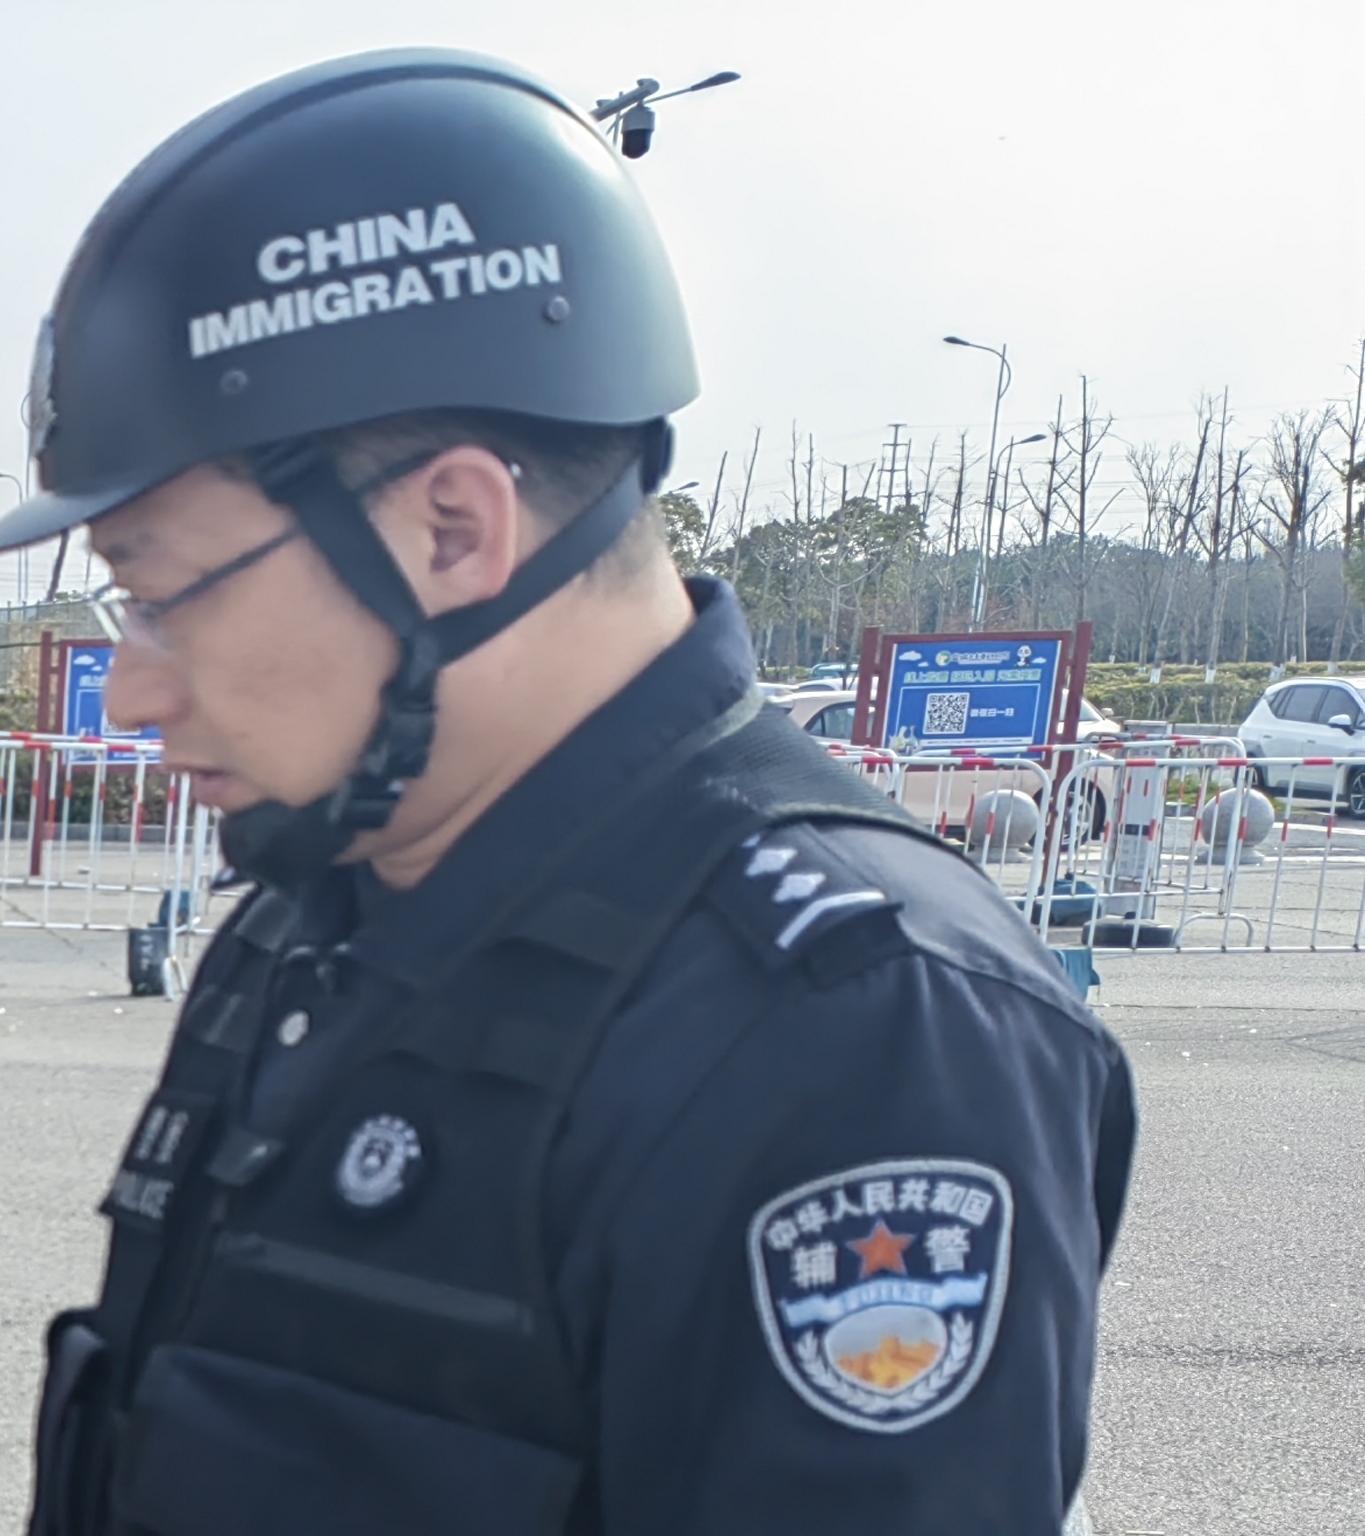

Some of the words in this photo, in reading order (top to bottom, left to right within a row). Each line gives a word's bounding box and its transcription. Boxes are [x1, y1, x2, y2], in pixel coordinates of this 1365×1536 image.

[257, 202, 476, 283] CHINA
[189, 244, 563, 358] IMMIGRATION
[765, 1178, 994, 1251] 中华人民共和国
